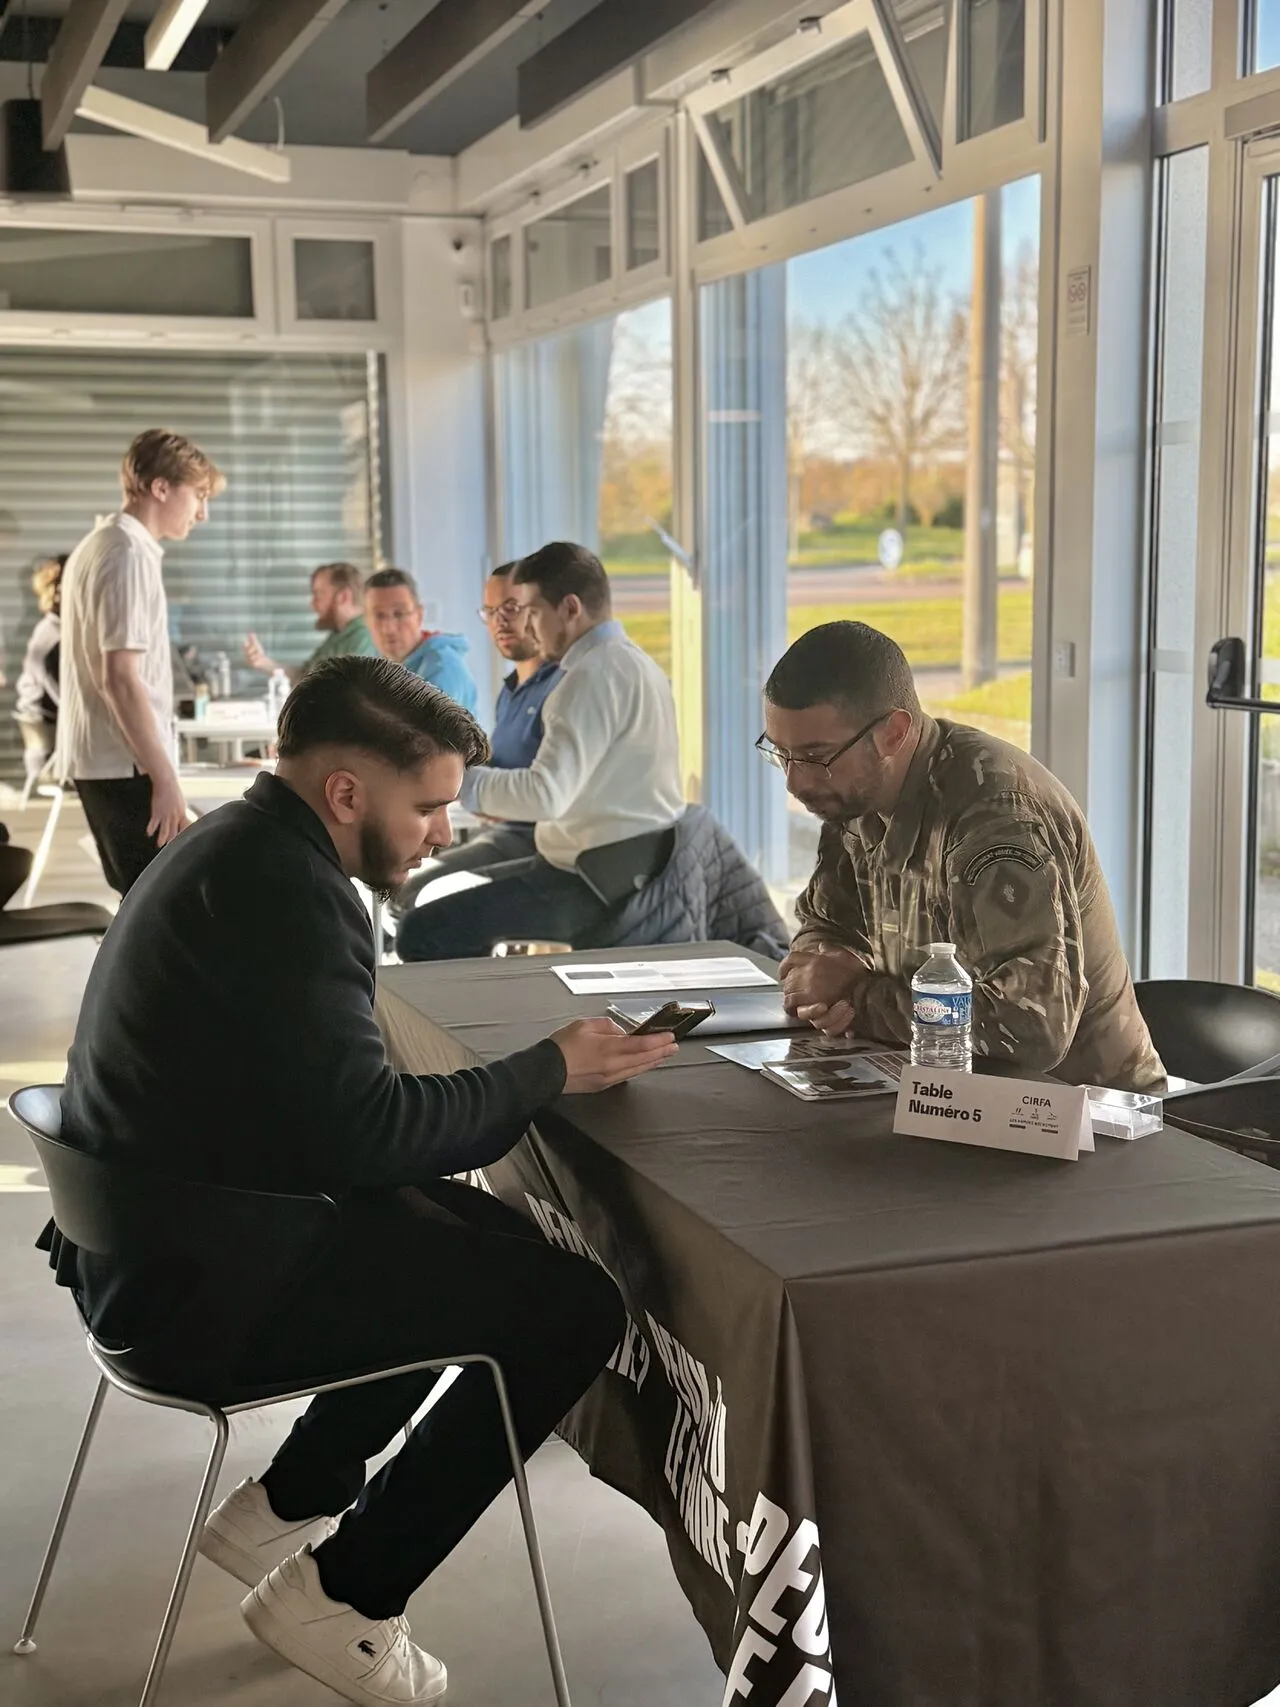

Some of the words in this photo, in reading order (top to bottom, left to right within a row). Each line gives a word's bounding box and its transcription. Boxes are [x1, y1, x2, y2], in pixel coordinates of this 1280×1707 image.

[912, 1081, 953, 1099] Table
[908, 1099, 970, 1120] Numéro
[972, 1108, 982, 1123] 5
[1022, 1095, 1051, 1108] CIRFA
[680, 1429, 736, 1597] FAIRE
